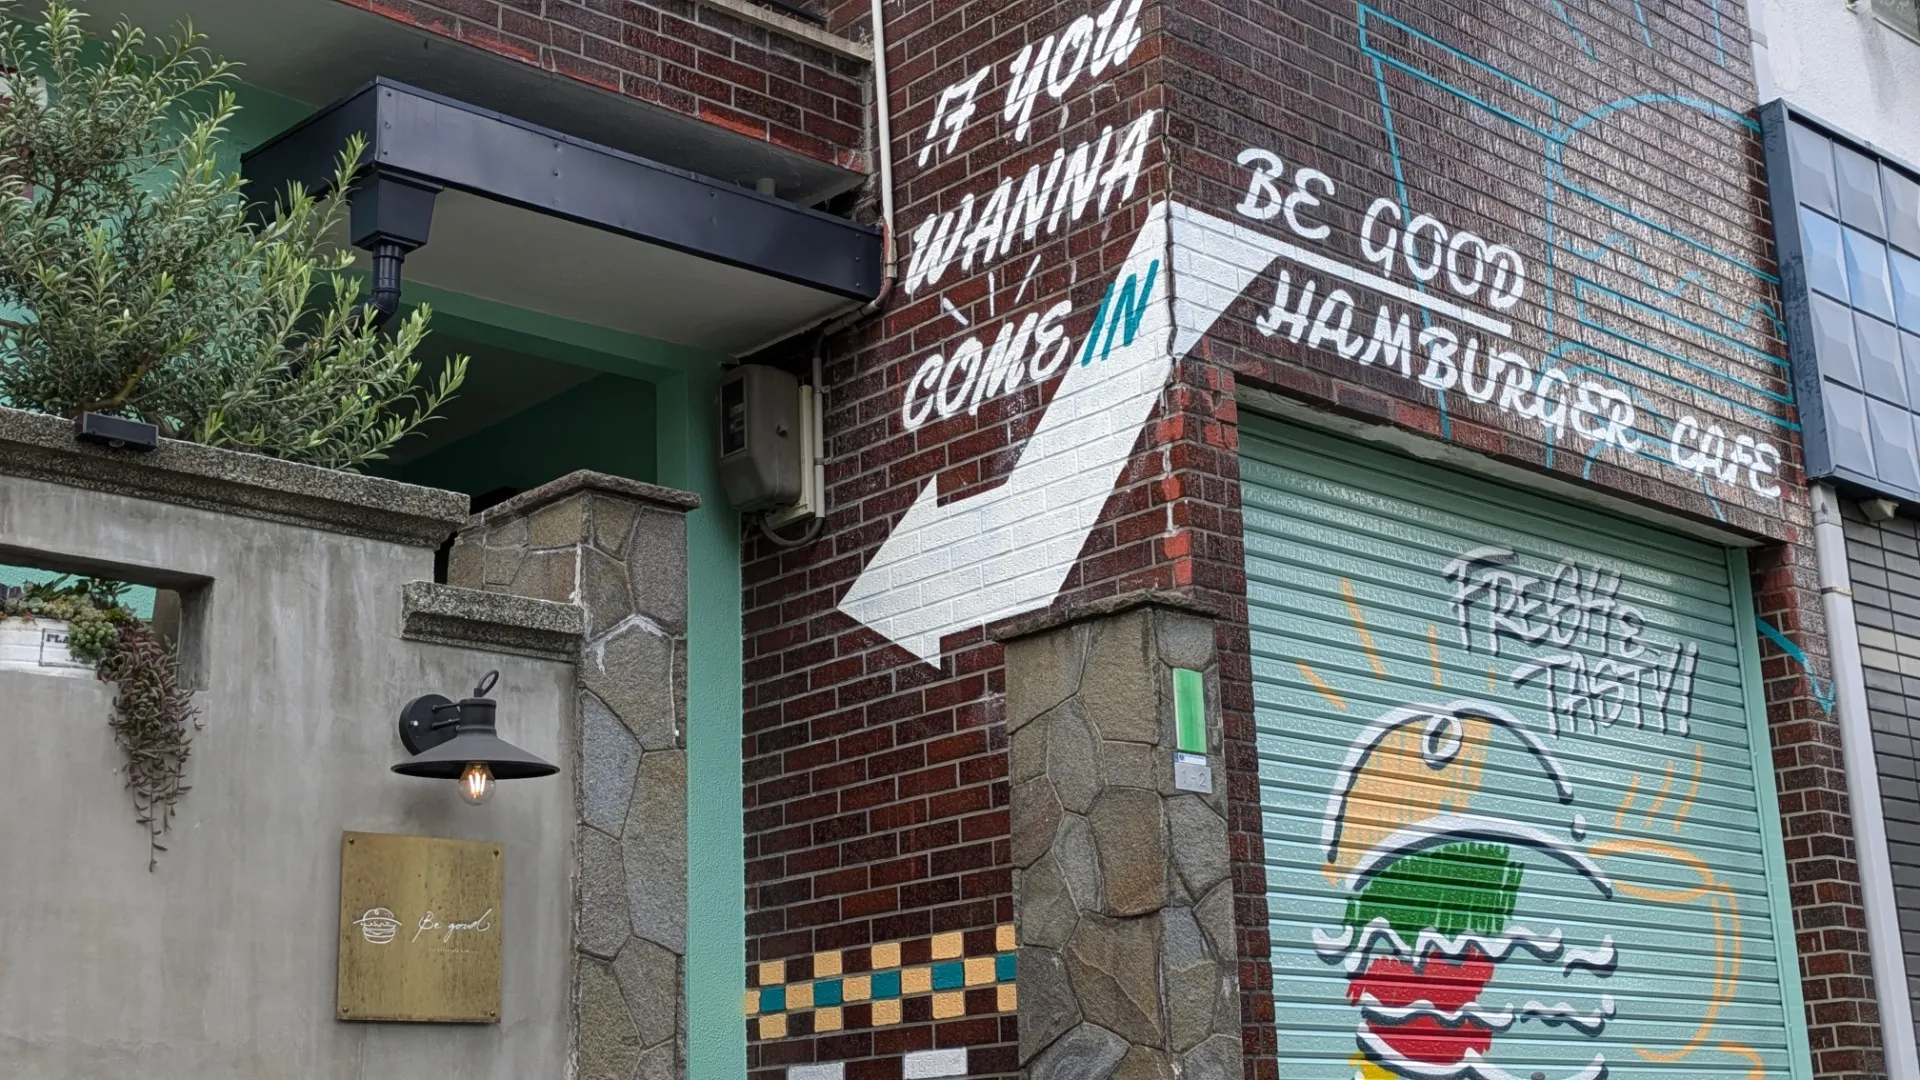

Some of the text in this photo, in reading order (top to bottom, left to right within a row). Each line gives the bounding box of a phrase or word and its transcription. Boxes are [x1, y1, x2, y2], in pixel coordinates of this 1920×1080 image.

[918, 0, 1142, 168] IF YOU
[905, 109, 1154, 294] WANNA
[1236, 147, 1525, 310] BE GOOD
[902, 259, 1160, 432] COME IN
[1256, 269, 1782, 500] HAMBURGER CAFE
[411, 907, 493, 944] Be good
